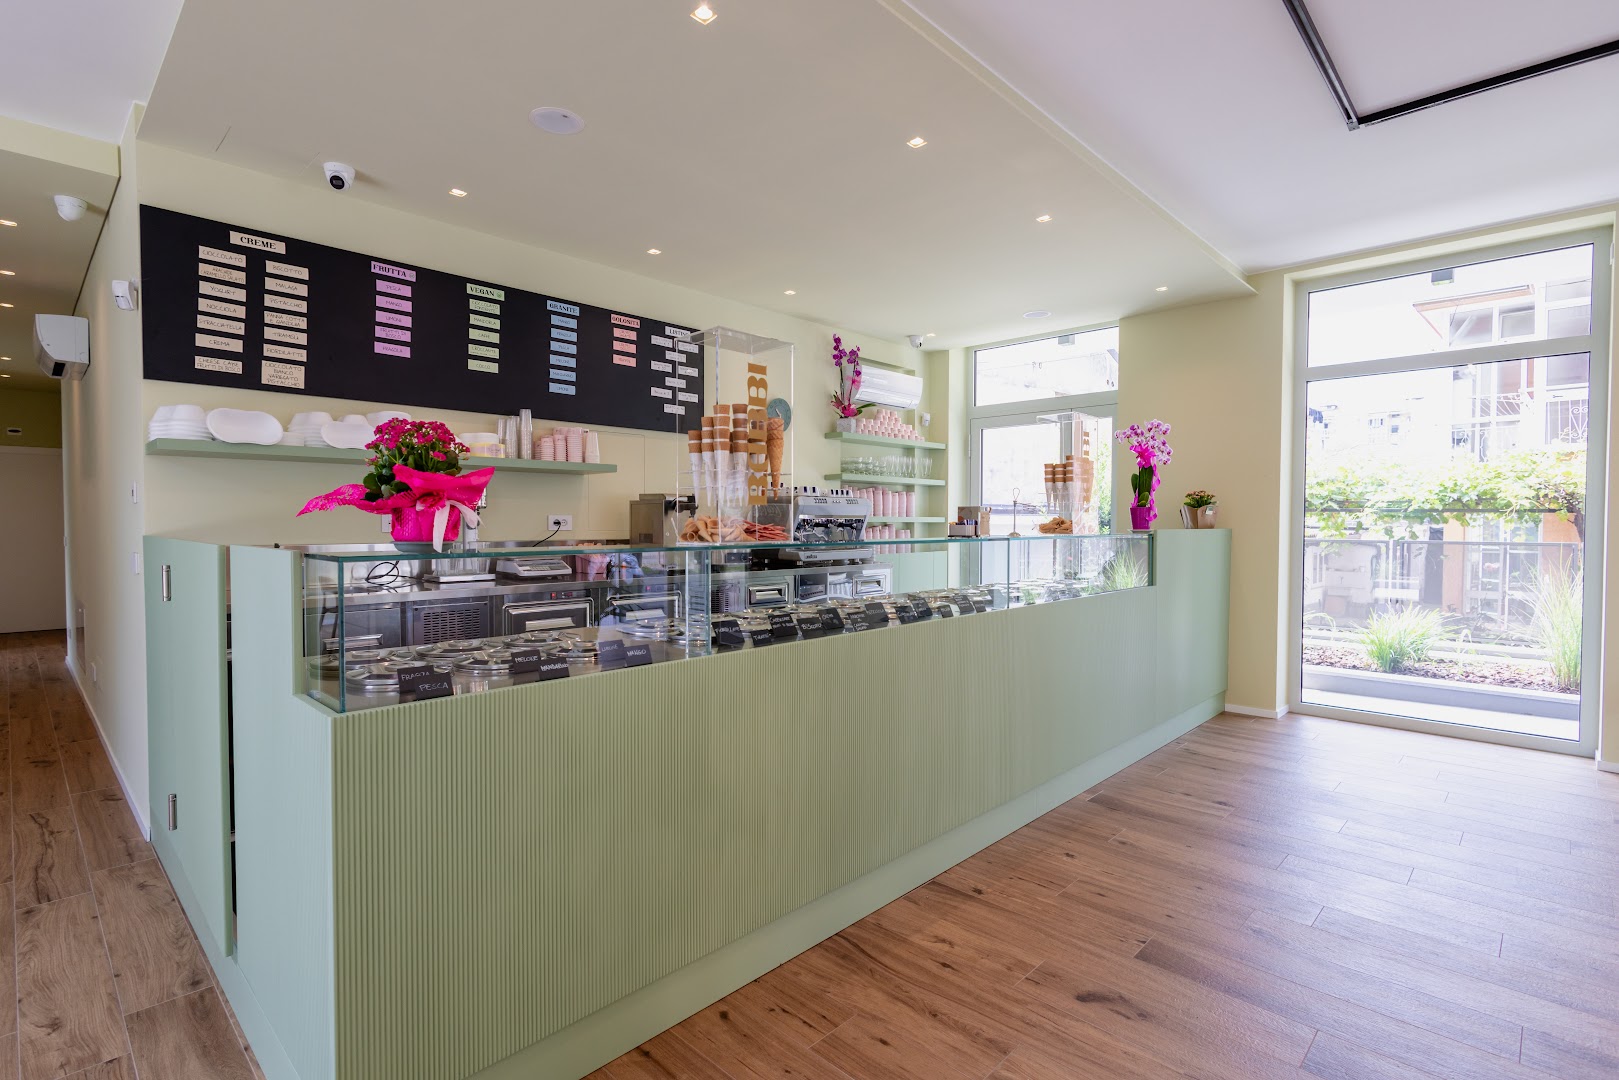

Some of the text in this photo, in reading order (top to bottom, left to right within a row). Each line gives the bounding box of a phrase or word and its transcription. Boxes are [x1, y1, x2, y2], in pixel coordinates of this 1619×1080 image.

[240, 236, 277, 250] CREME
[202, 249, 243, 263] CIOCCOLATO
[272, 264, 303, 275] BISCOTTO
[372, 264, 407, 278] FRUTTA
[209, 285, 236, 295] YOGURT
[275, 282, 298, 291] MALAGA
[470, 286, 495, 297] VEGAN
[269, 297, 303, 308] PISTACCHIO
[386, 300, 402, 308] MANGO
[206, 303, 237, 314] NOCCIOLA
[549, 303, 578, 314] GRANITE
[198, 319, 242, 331] STRACCIATELLA
[208, 339, 230, 347] CREMA
[264, 362, 302, 372] CIOCCOLATO
[626, 648, 647, 657] MANGO
[419, 682, 449, 692] PESCA
